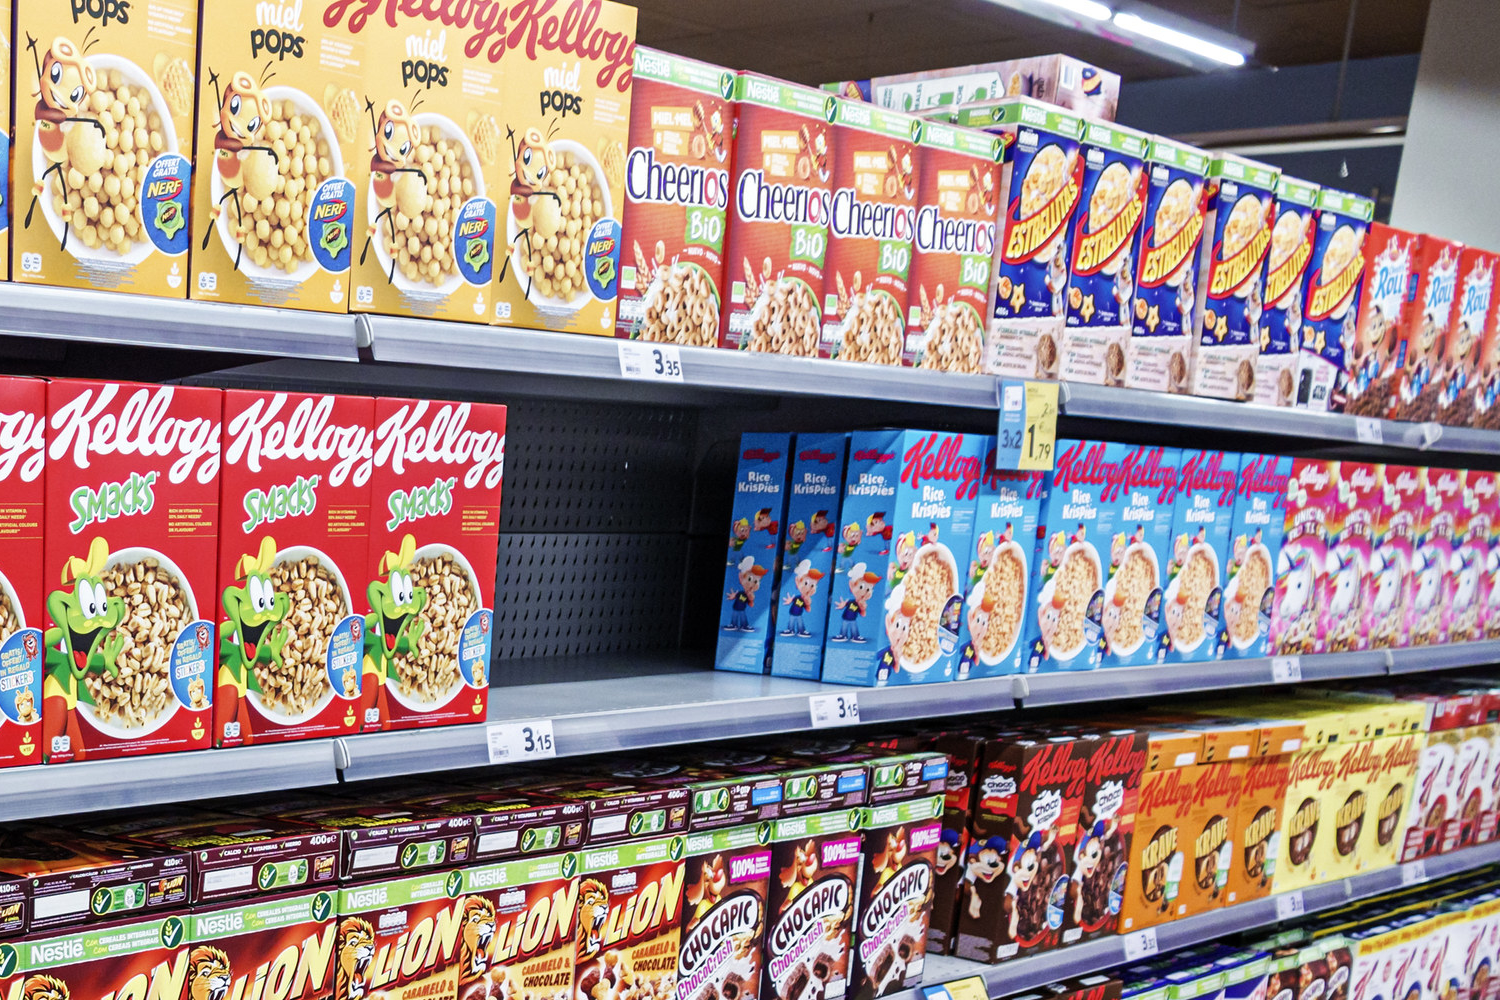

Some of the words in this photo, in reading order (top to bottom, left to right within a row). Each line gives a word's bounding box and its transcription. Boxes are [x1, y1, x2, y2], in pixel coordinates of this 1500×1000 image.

[251, 30, 304, 59] pops
[406, 30, 447, 62] miel
[402, 62, 448, 88] pops
[544, 63, 580, 92] miel
[540, 90, 581, 116] pops
[147, 179, 182, 199] NERF
[627, 146, 728, 211] Cheerios
[737, 168, 831, 228] Cheerios
[830, 188, 915, 243] Cheerios
[915, 204, 995, 257] Cheerios
[1006, 181, 1079, 260] ESTRELLITAS
[1077, 196, 1143, 270] ESTRELLITAS
[1142, 212, 1204, 283] ESTRELLITAS
[1212, 223, 1272, 294] ESTRELLITAS
[912, 501, 951, 519] Krispies
[680, 899, 753, 975] CHOCAPIC
[772, 881, 844, 954] CHOCAPIC
